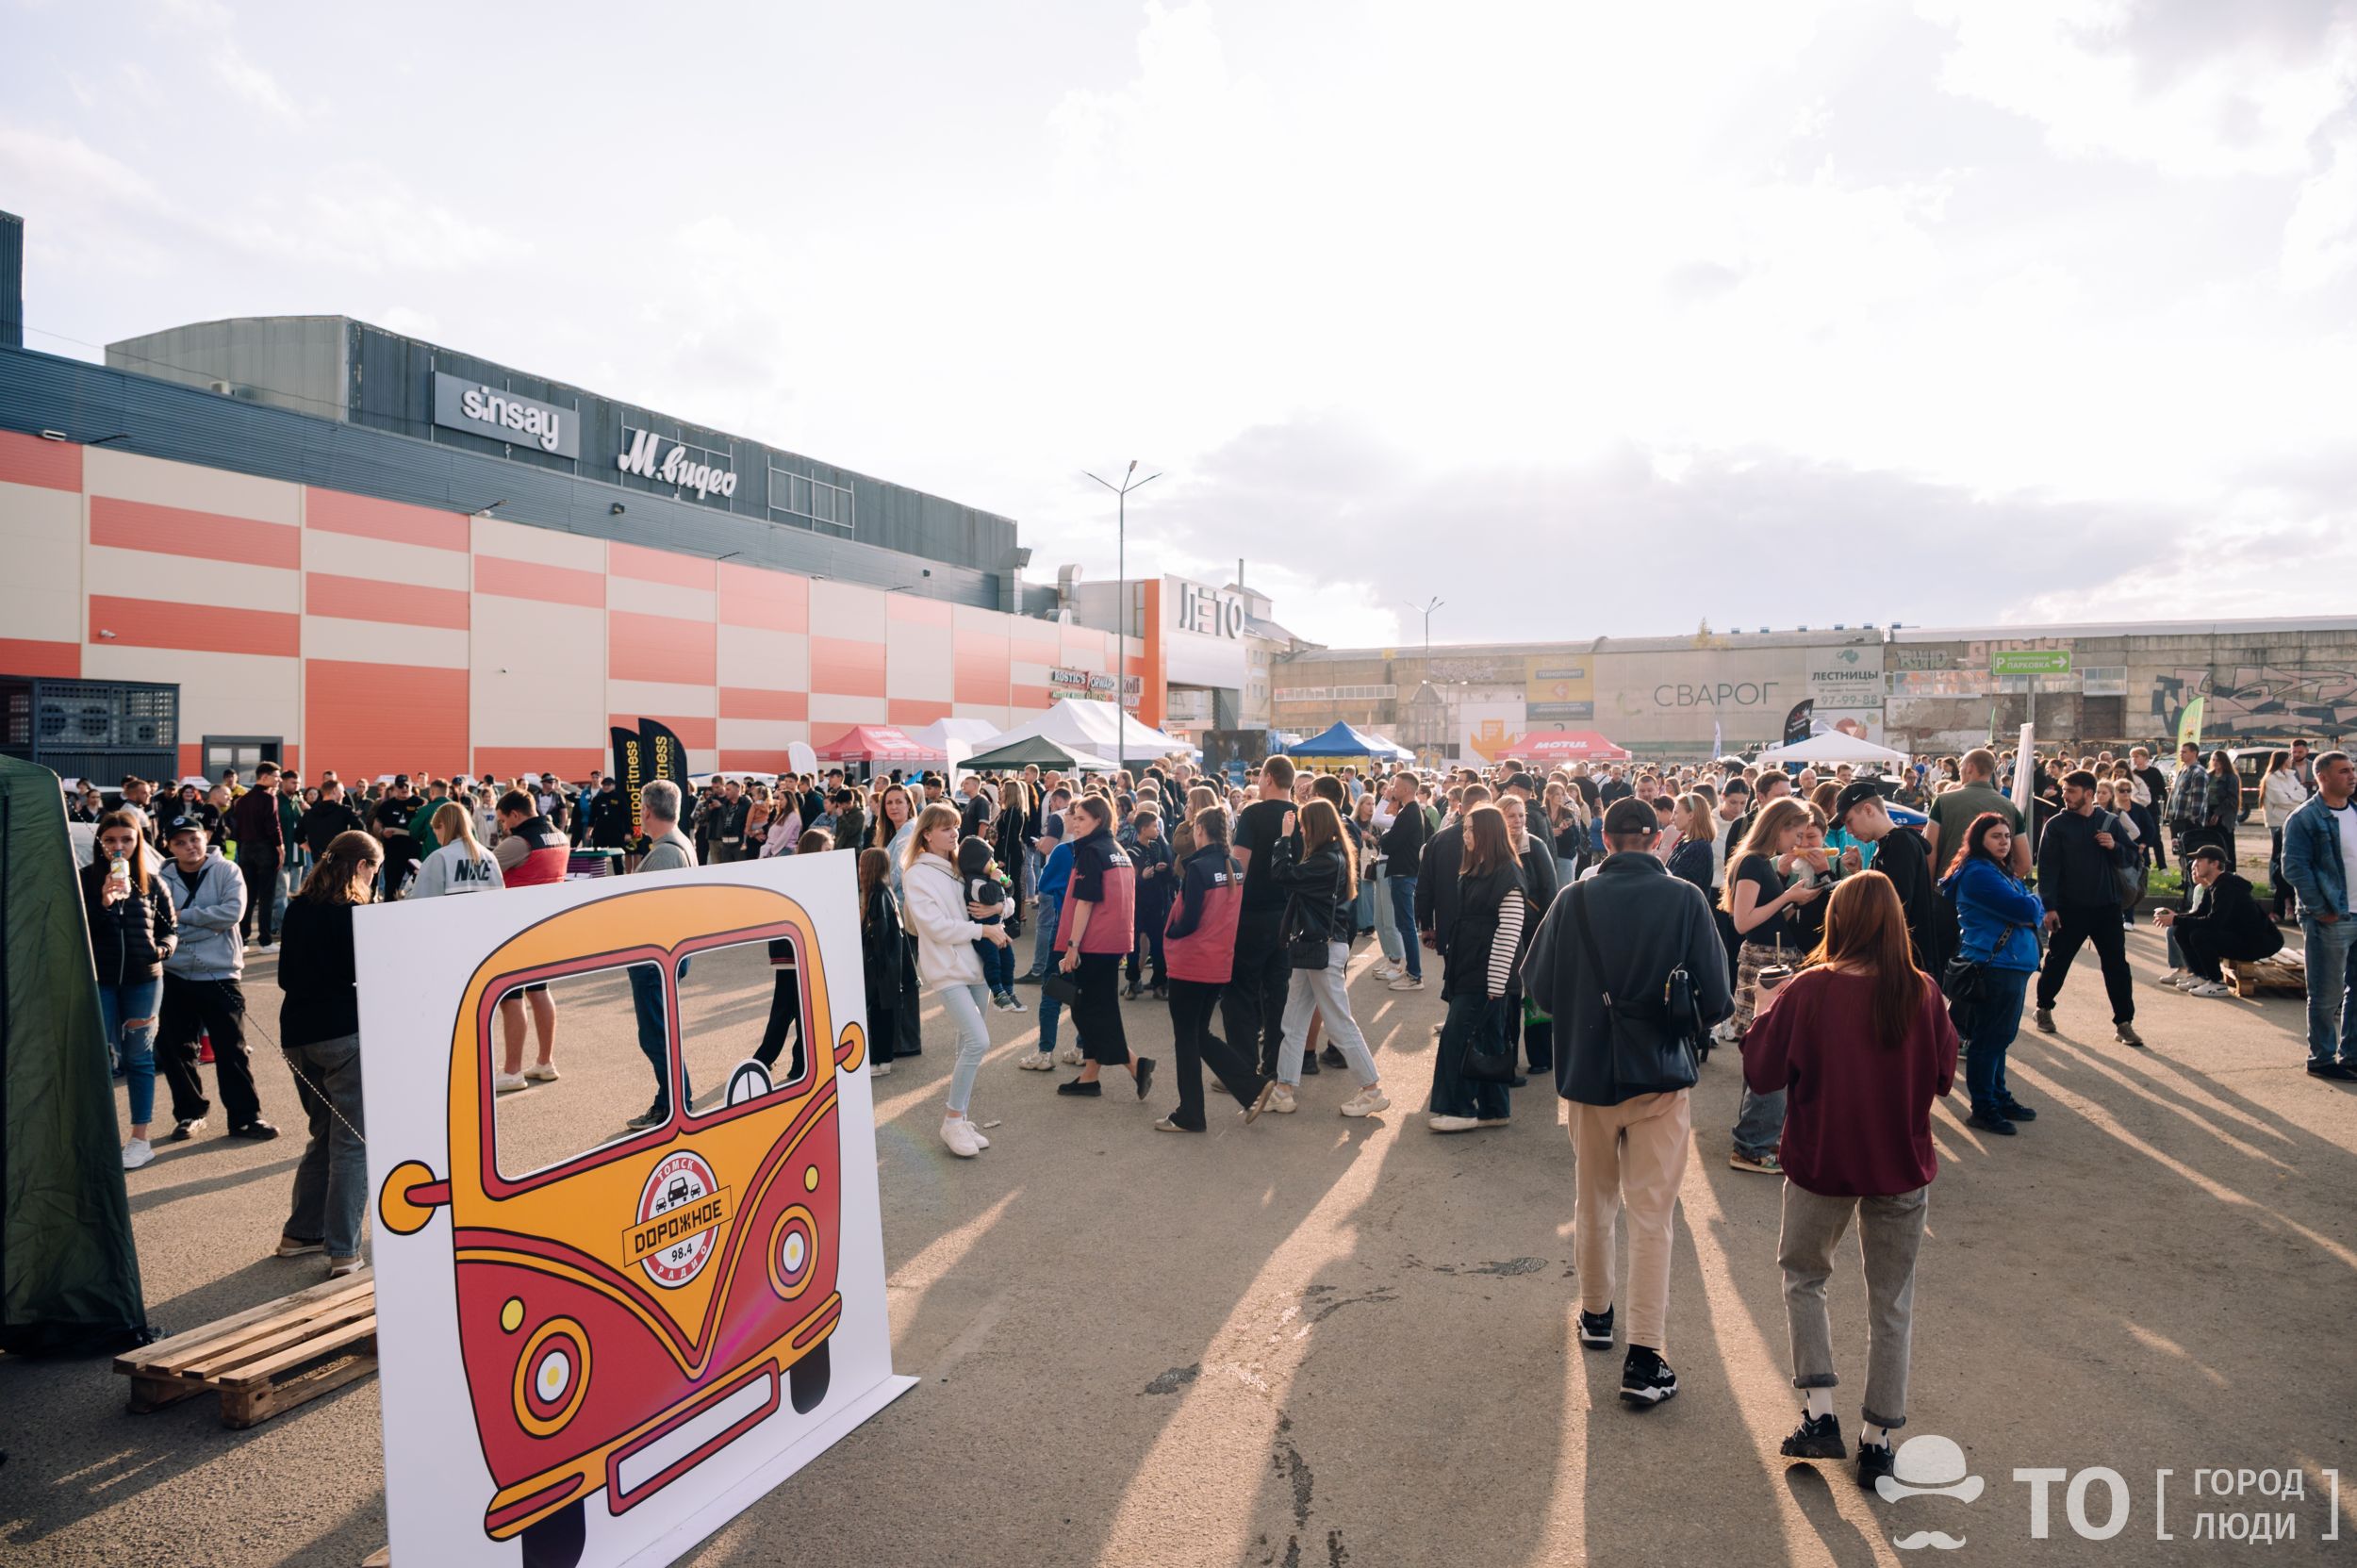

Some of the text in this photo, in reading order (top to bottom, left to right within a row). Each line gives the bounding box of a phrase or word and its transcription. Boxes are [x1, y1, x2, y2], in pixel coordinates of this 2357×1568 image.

[461, 386, 559, 452] sinsay
[618, 428, 737, 500] М.видео
[1179, 582, 1244, 640] ЛЕТО
[1053, 669, 1087, 685] ROSTIC'S
[1812, 670, 1879, 681] ЛЕСТНИЦЫ
[1654, 682, 1780, 707] СВАРОГ
[1821, 694, 1878, 705] 97-99-88
[1534, 740, 1589, 750] MOTUL
[658, 1158, 695, 1180] ТОМСК
[635, 1199, 723, 1254] ДОРОЖНОЕ
[657, 1245, 707, 1279] РАДИО
[671, 1243, 693, 1262] 98.4
